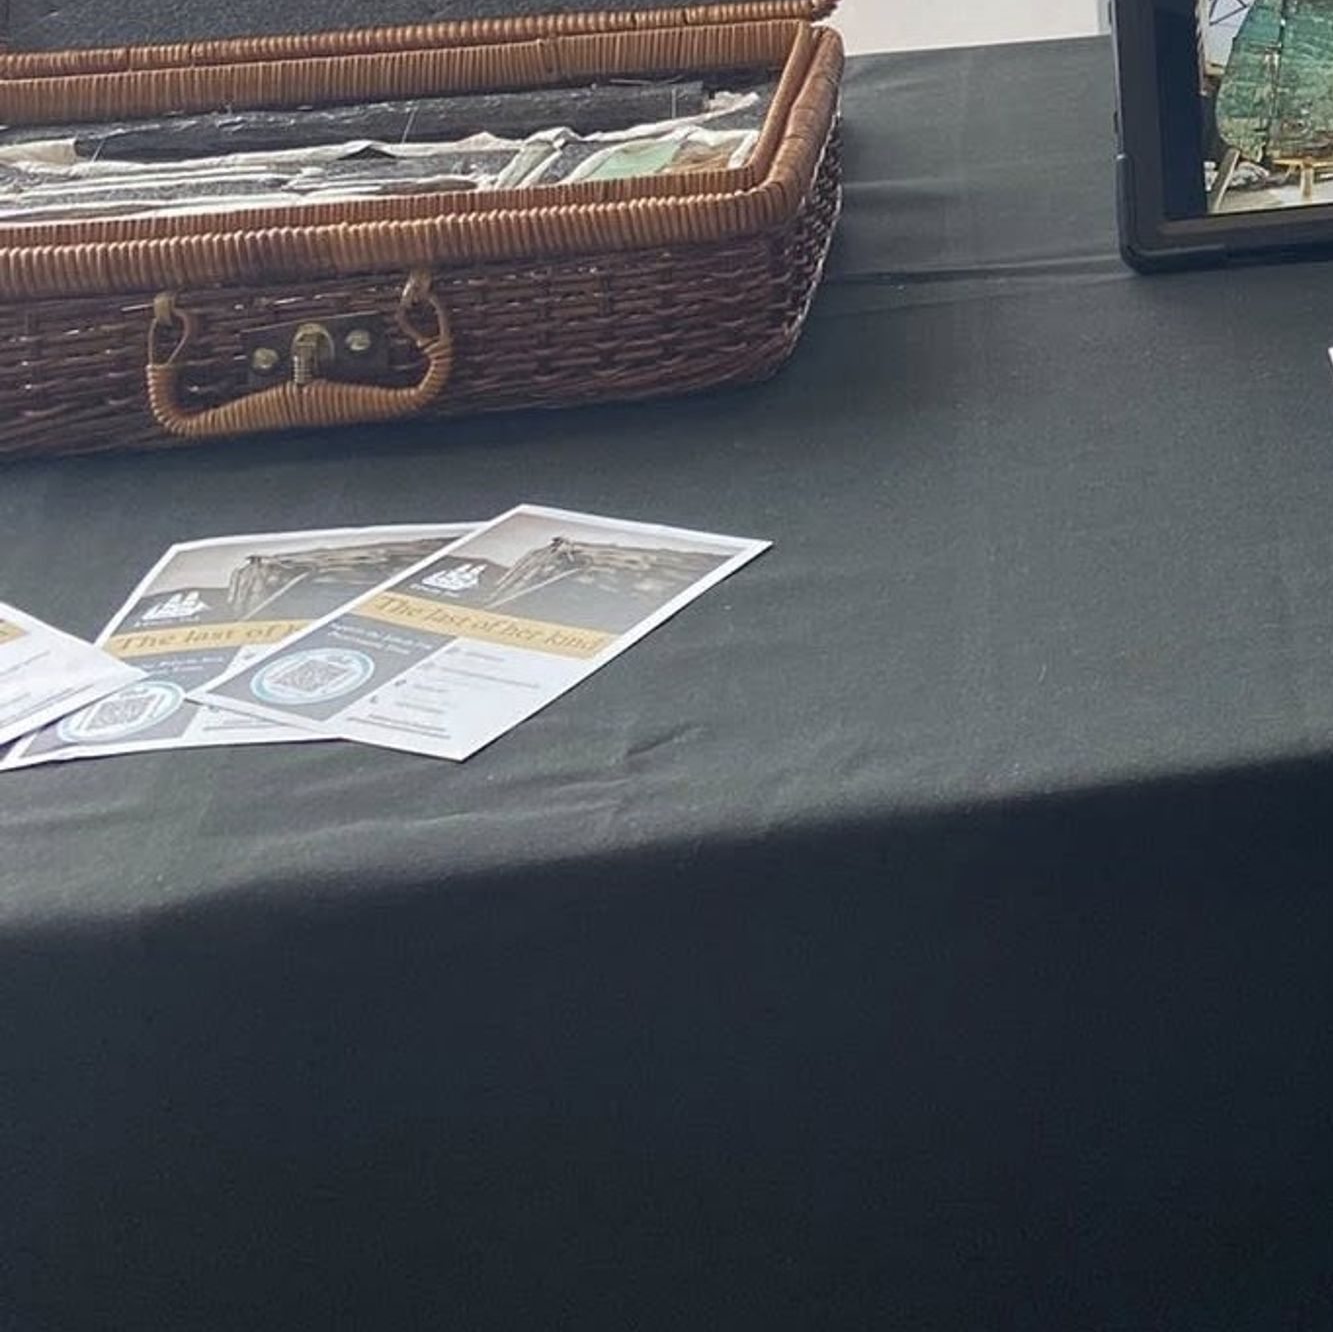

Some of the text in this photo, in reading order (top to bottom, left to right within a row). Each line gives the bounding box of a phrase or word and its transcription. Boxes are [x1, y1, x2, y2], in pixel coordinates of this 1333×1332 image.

[116, 633, 176, 651] The
[183, 628, 233, 644] last
[246, 622, 278, 640] of
[375, 595, 600, 653] The last of her kind
